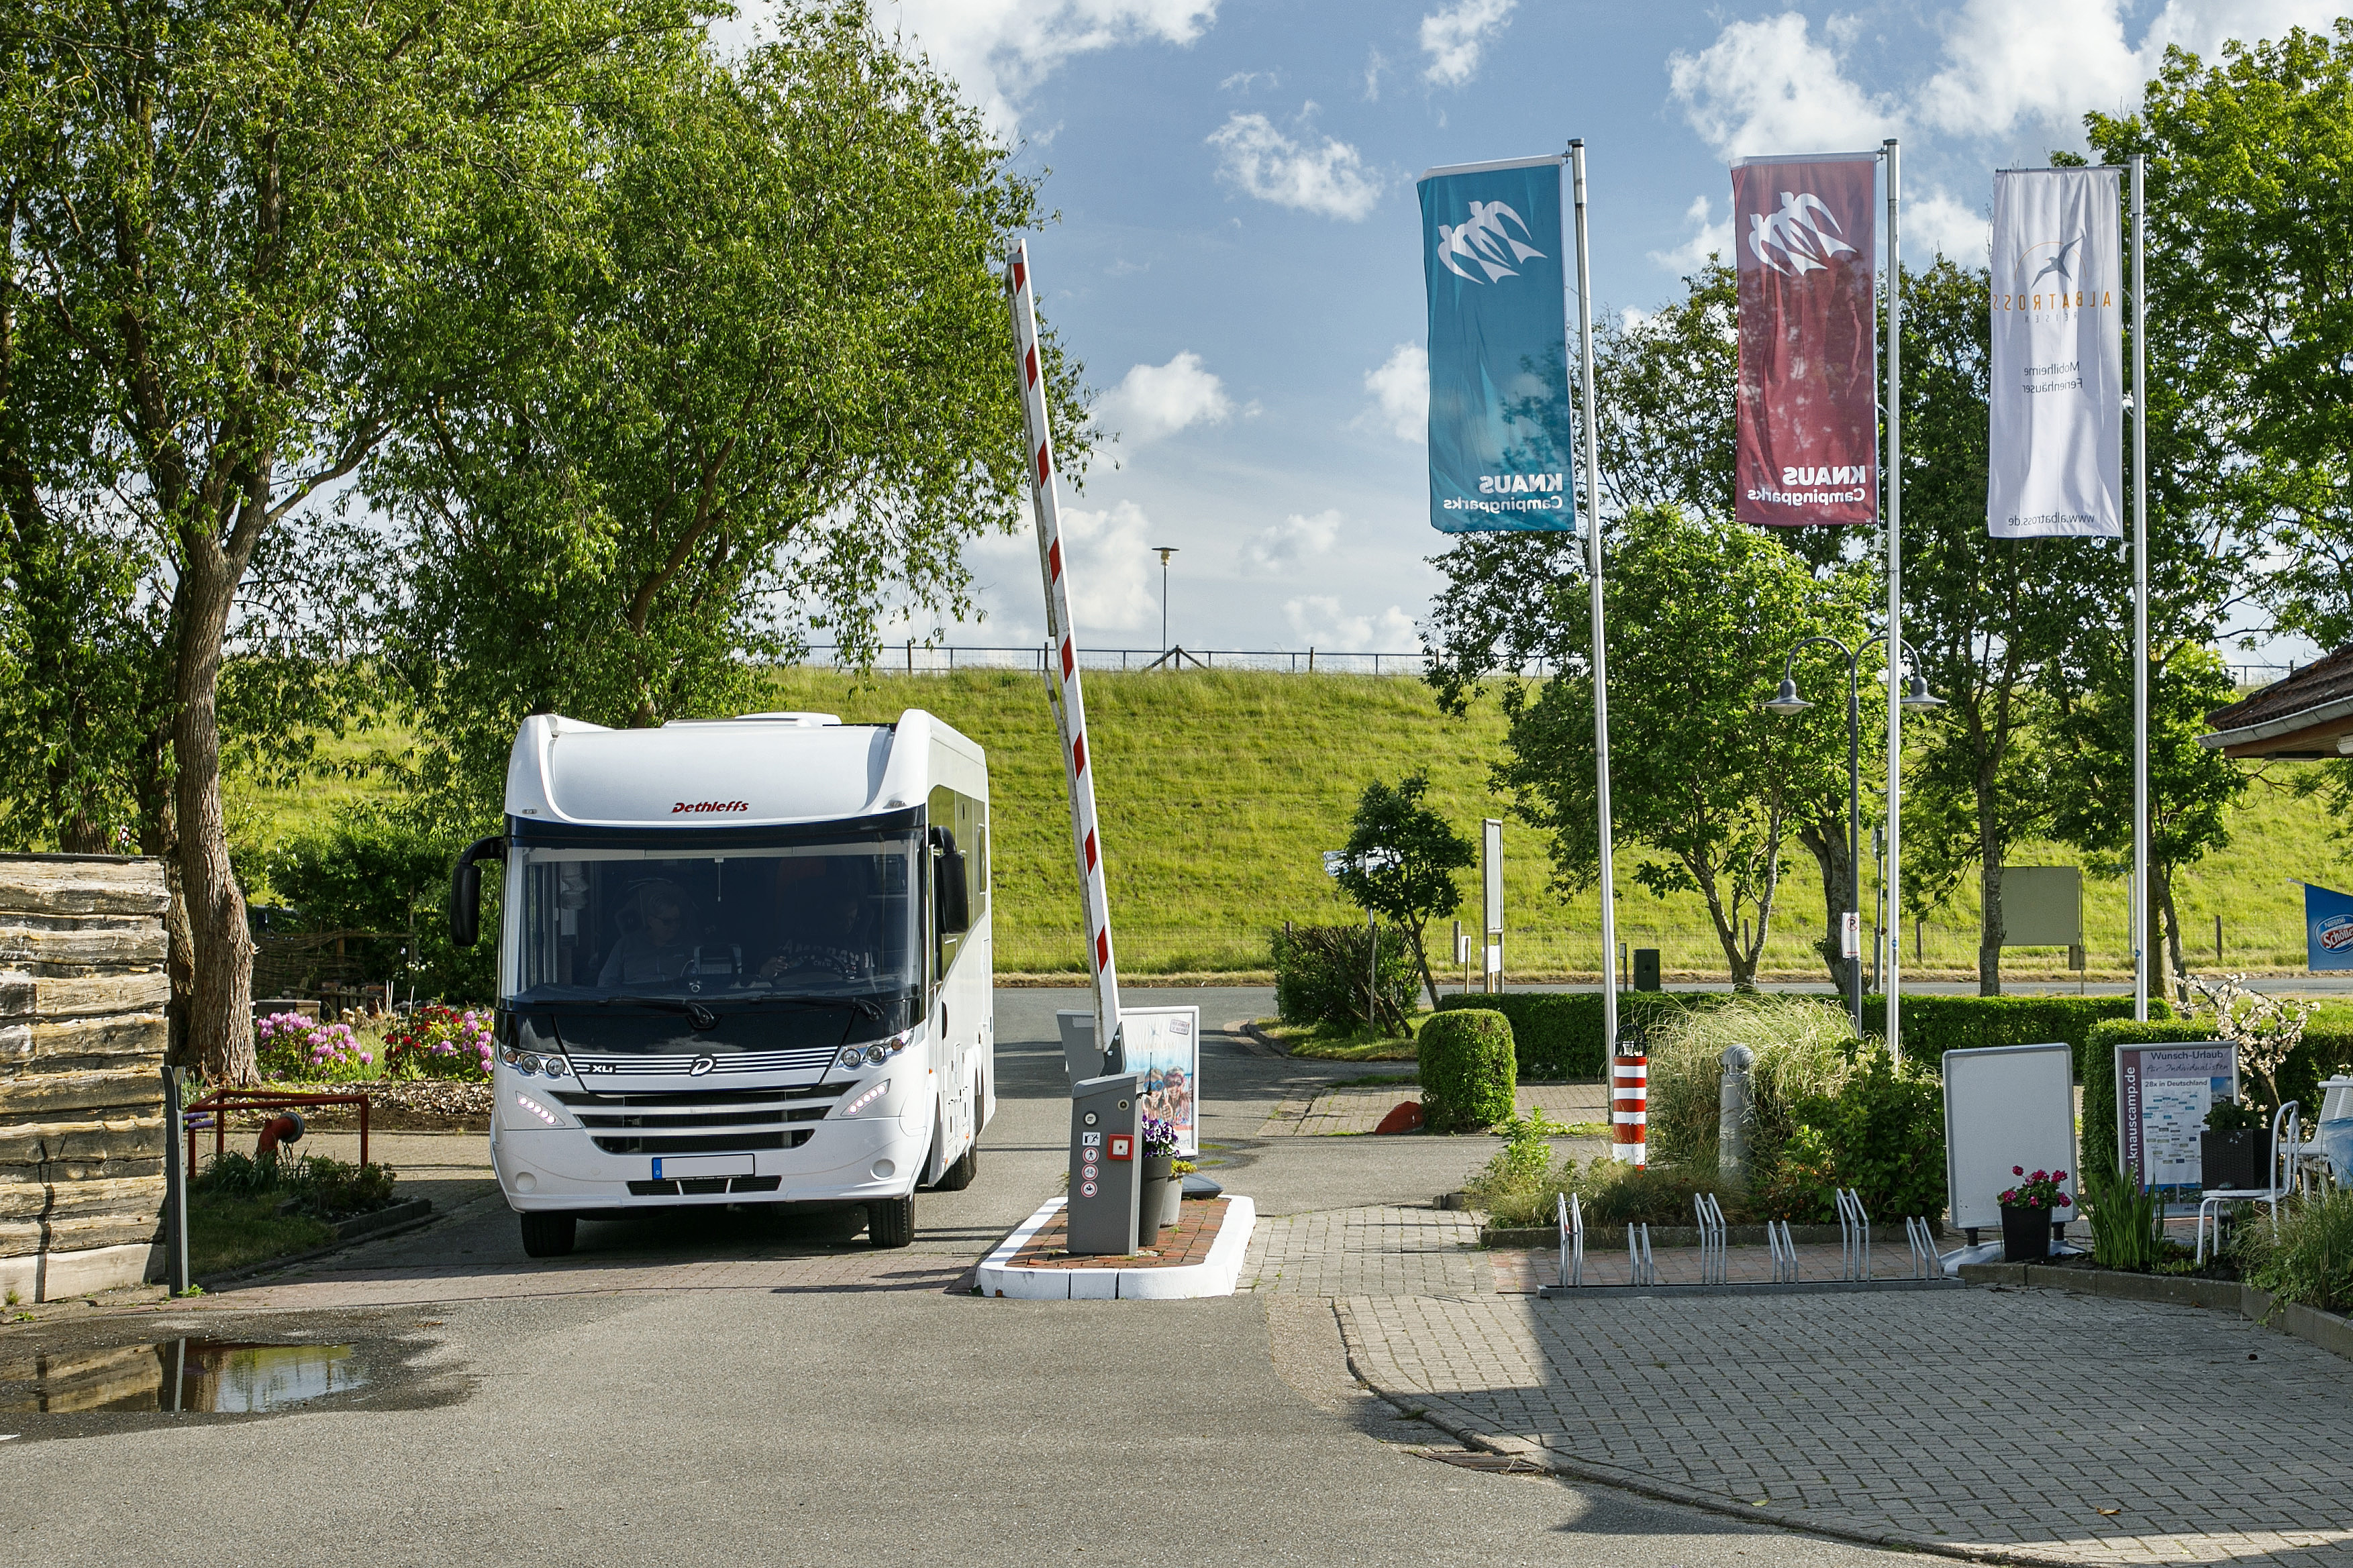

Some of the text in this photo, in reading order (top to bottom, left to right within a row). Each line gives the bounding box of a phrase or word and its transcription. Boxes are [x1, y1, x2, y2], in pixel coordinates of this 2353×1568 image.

[671, 800, 750, 814] Dethleffs
[2323, 927, 2353, 949] Schölle
[2150, 1050, 2223, 1060] Wunsch-Urlaub
[2164, 1062, 2228, 1072] Individualisten
